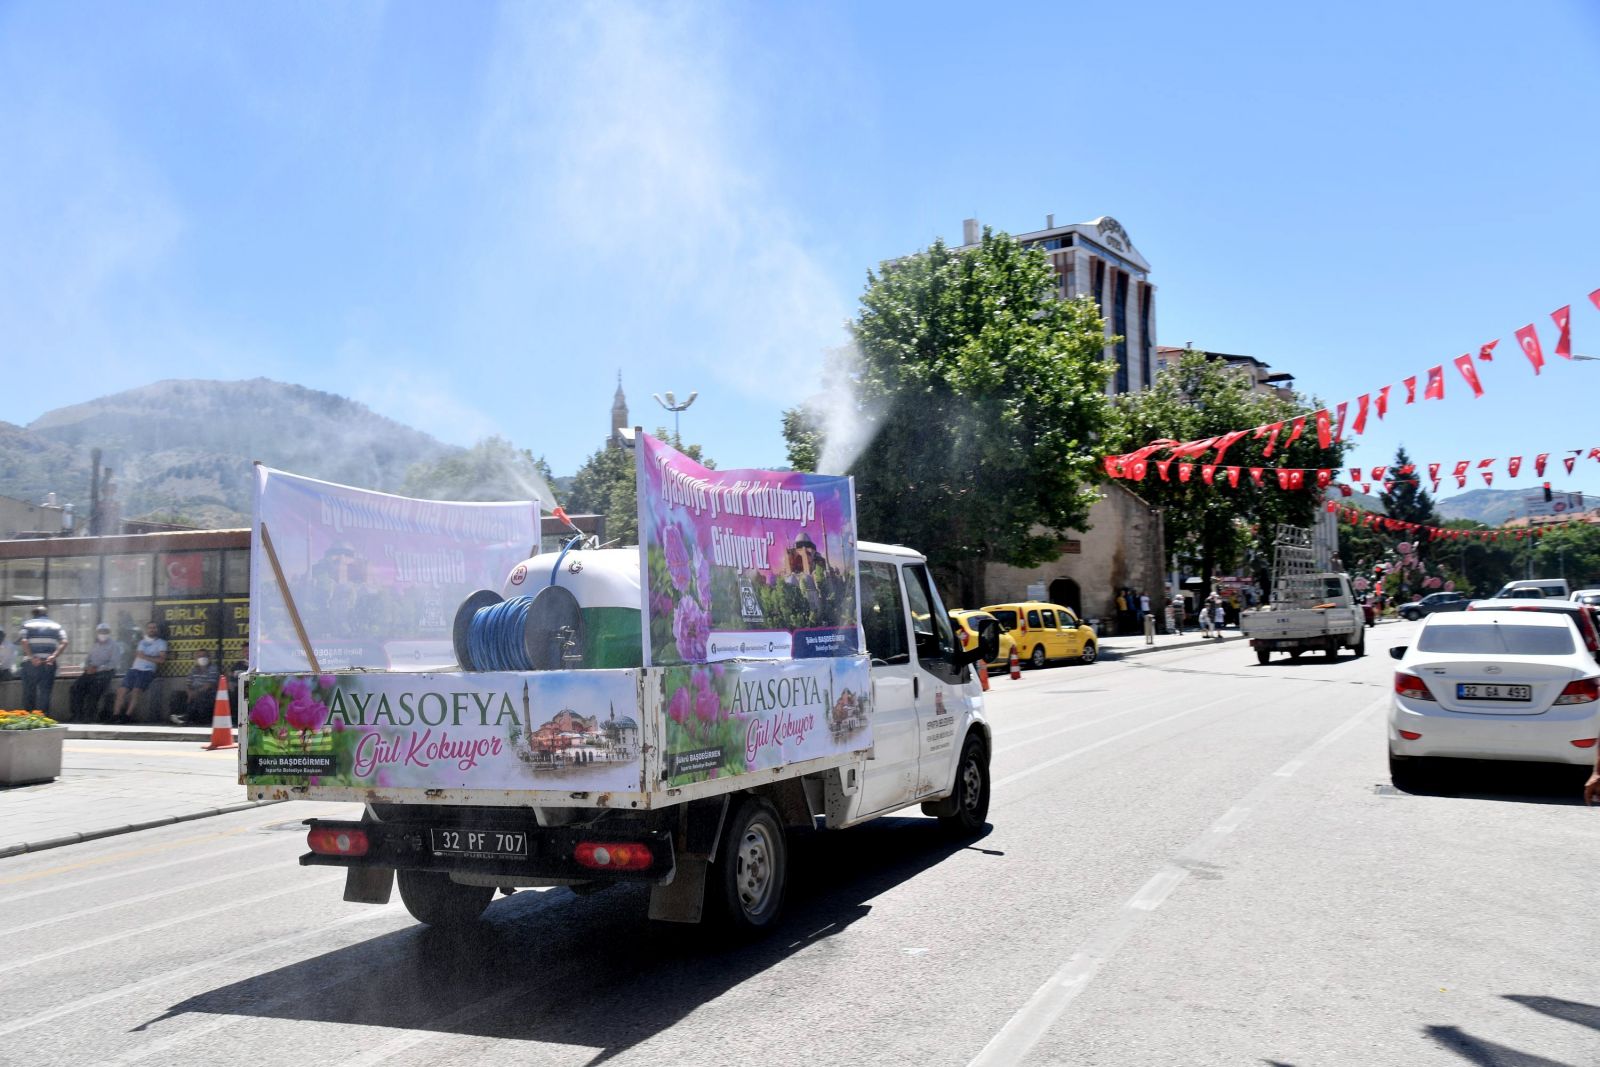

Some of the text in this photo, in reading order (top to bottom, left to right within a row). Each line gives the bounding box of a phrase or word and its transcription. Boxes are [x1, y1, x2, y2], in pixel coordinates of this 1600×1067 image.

[747, 481, 815, 527] Kokutmaya
[165, 606, 208, 620] BİRLİK
[168, 622, 206, 636] TAKSİ
[729, 676, 822, 714] AYASOFYA
[1464, 686, 1528, 698] 32 GA 493
[323, 687, 523, 727] AYASOFYA
[746, 710, 814, 762] Gül Kokuyor
[258, 757, 330, 767] Şükrü BAŞDEĞİRMEN
[354, 728, 503, 777] Gül Kokuyor
[442, 831, 523, 852] 32 PF 707
